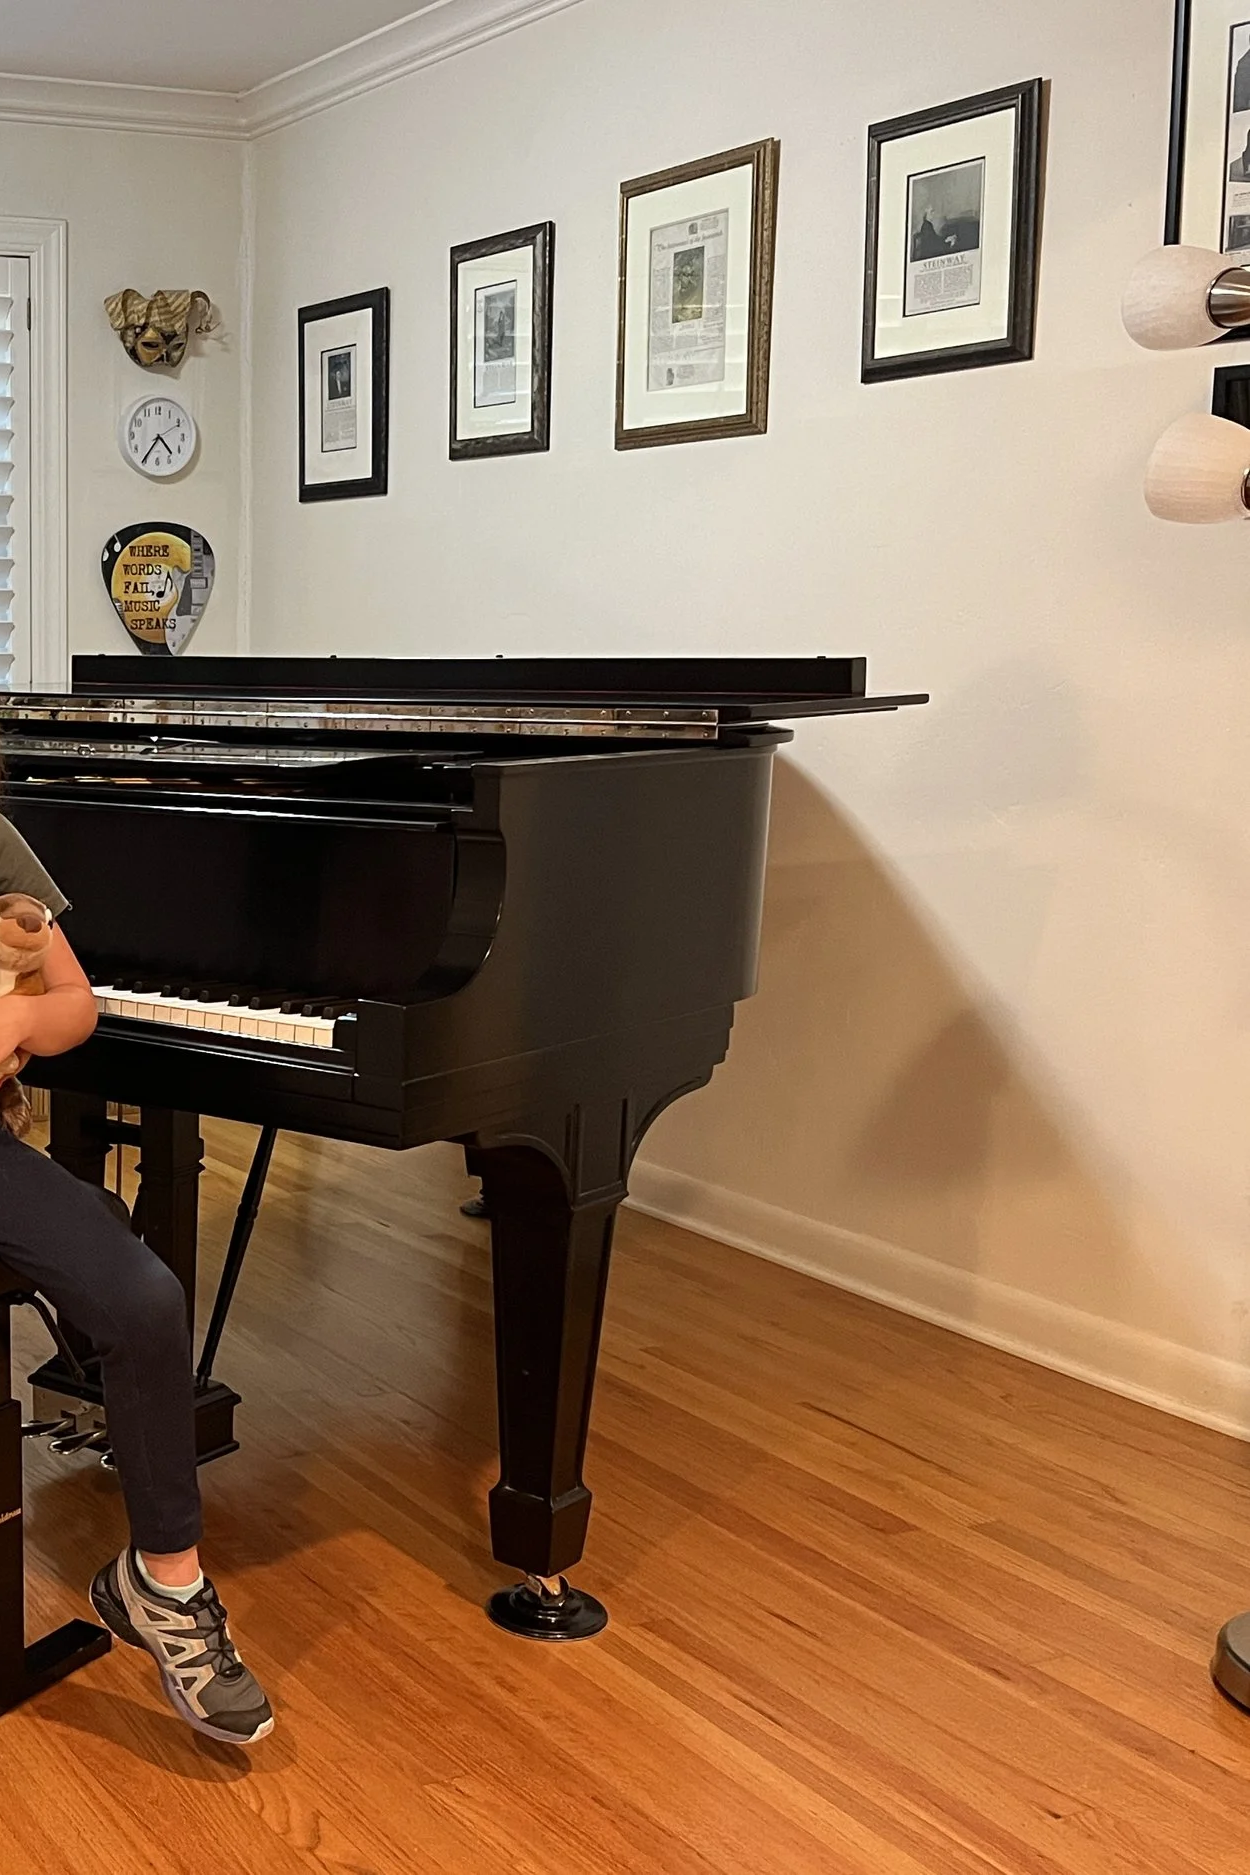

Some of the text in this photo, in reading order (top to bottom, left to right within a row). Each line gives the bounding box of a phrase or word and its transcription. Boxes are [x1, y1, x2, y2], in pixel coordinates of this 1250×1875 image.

[923, 254, 965, 269] STEINWAY
[144, 408, 150, 417] 11
[155, 406, 162, 415] 12
[134, 418, 142, 427] 10
[129, 545, 170, 557] WHERE
[123, 564, 161, 575] WORDS
[124, 582, 154, 595] FAIL,
[124, 600, 161, 612] MUSIC
[131, 618, 176, 630] SPEAKS
